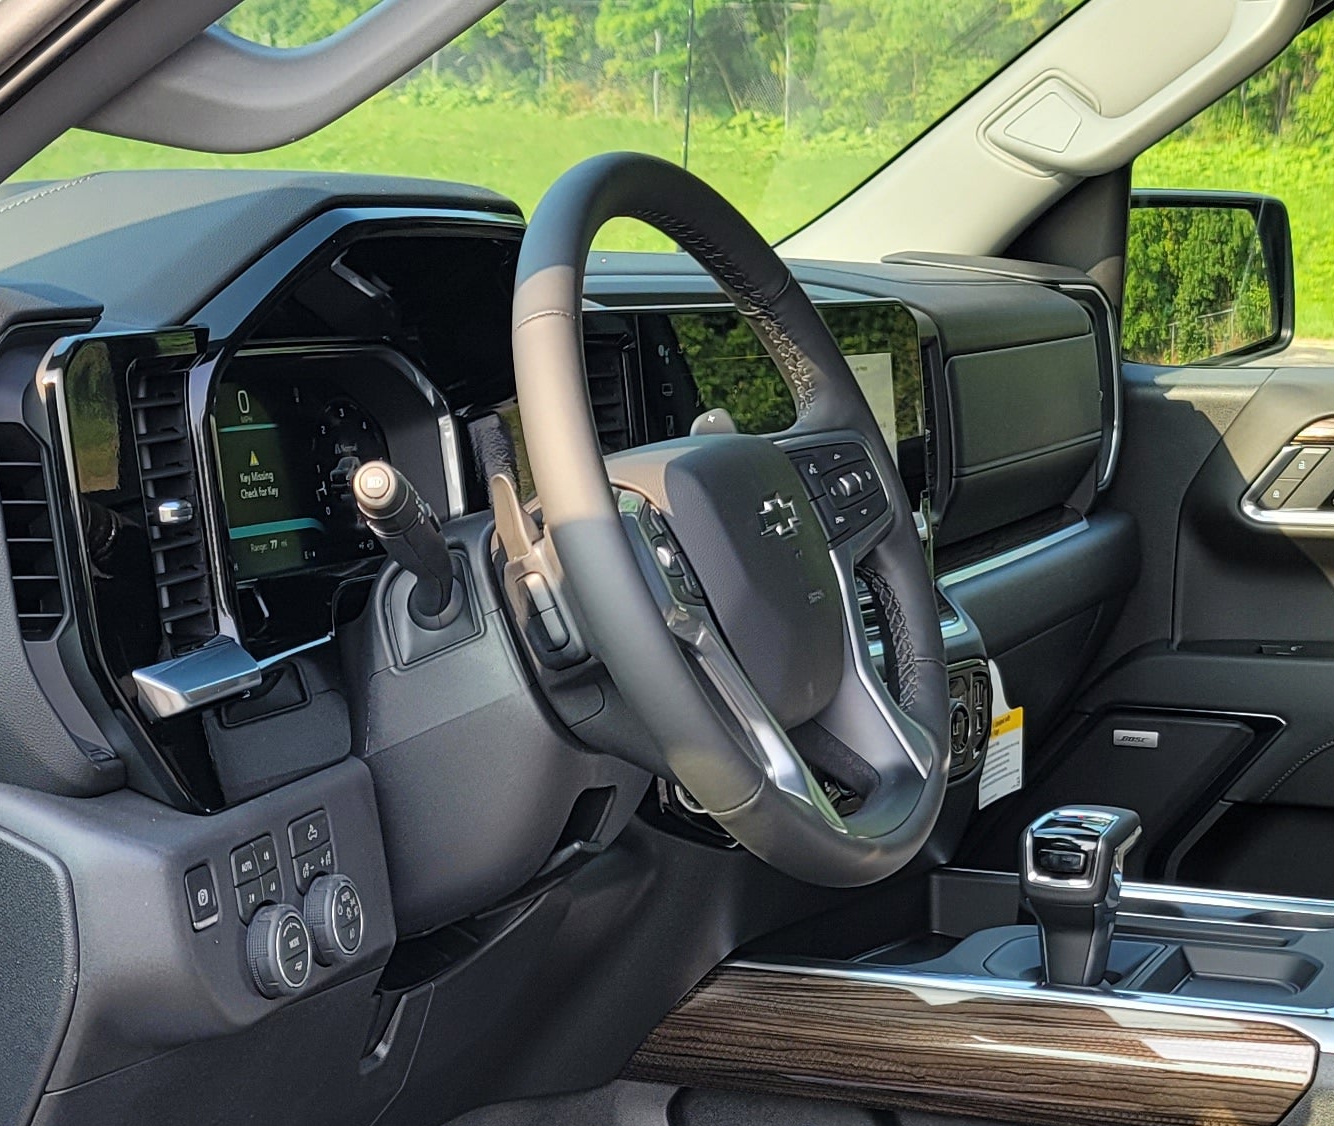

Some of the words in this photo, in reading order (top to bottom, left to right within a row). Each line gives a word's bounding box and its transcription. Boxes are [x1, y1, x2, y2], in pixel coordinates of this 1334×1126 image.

[240, 473, 251, 485] Key
[251, 471, 274, 482] Missing
[241, 488, 259, 499] Check
[259, 487, 268, 496] for
[268, 486, 279, 498] Key
[270, 539, 278, 549] 77
